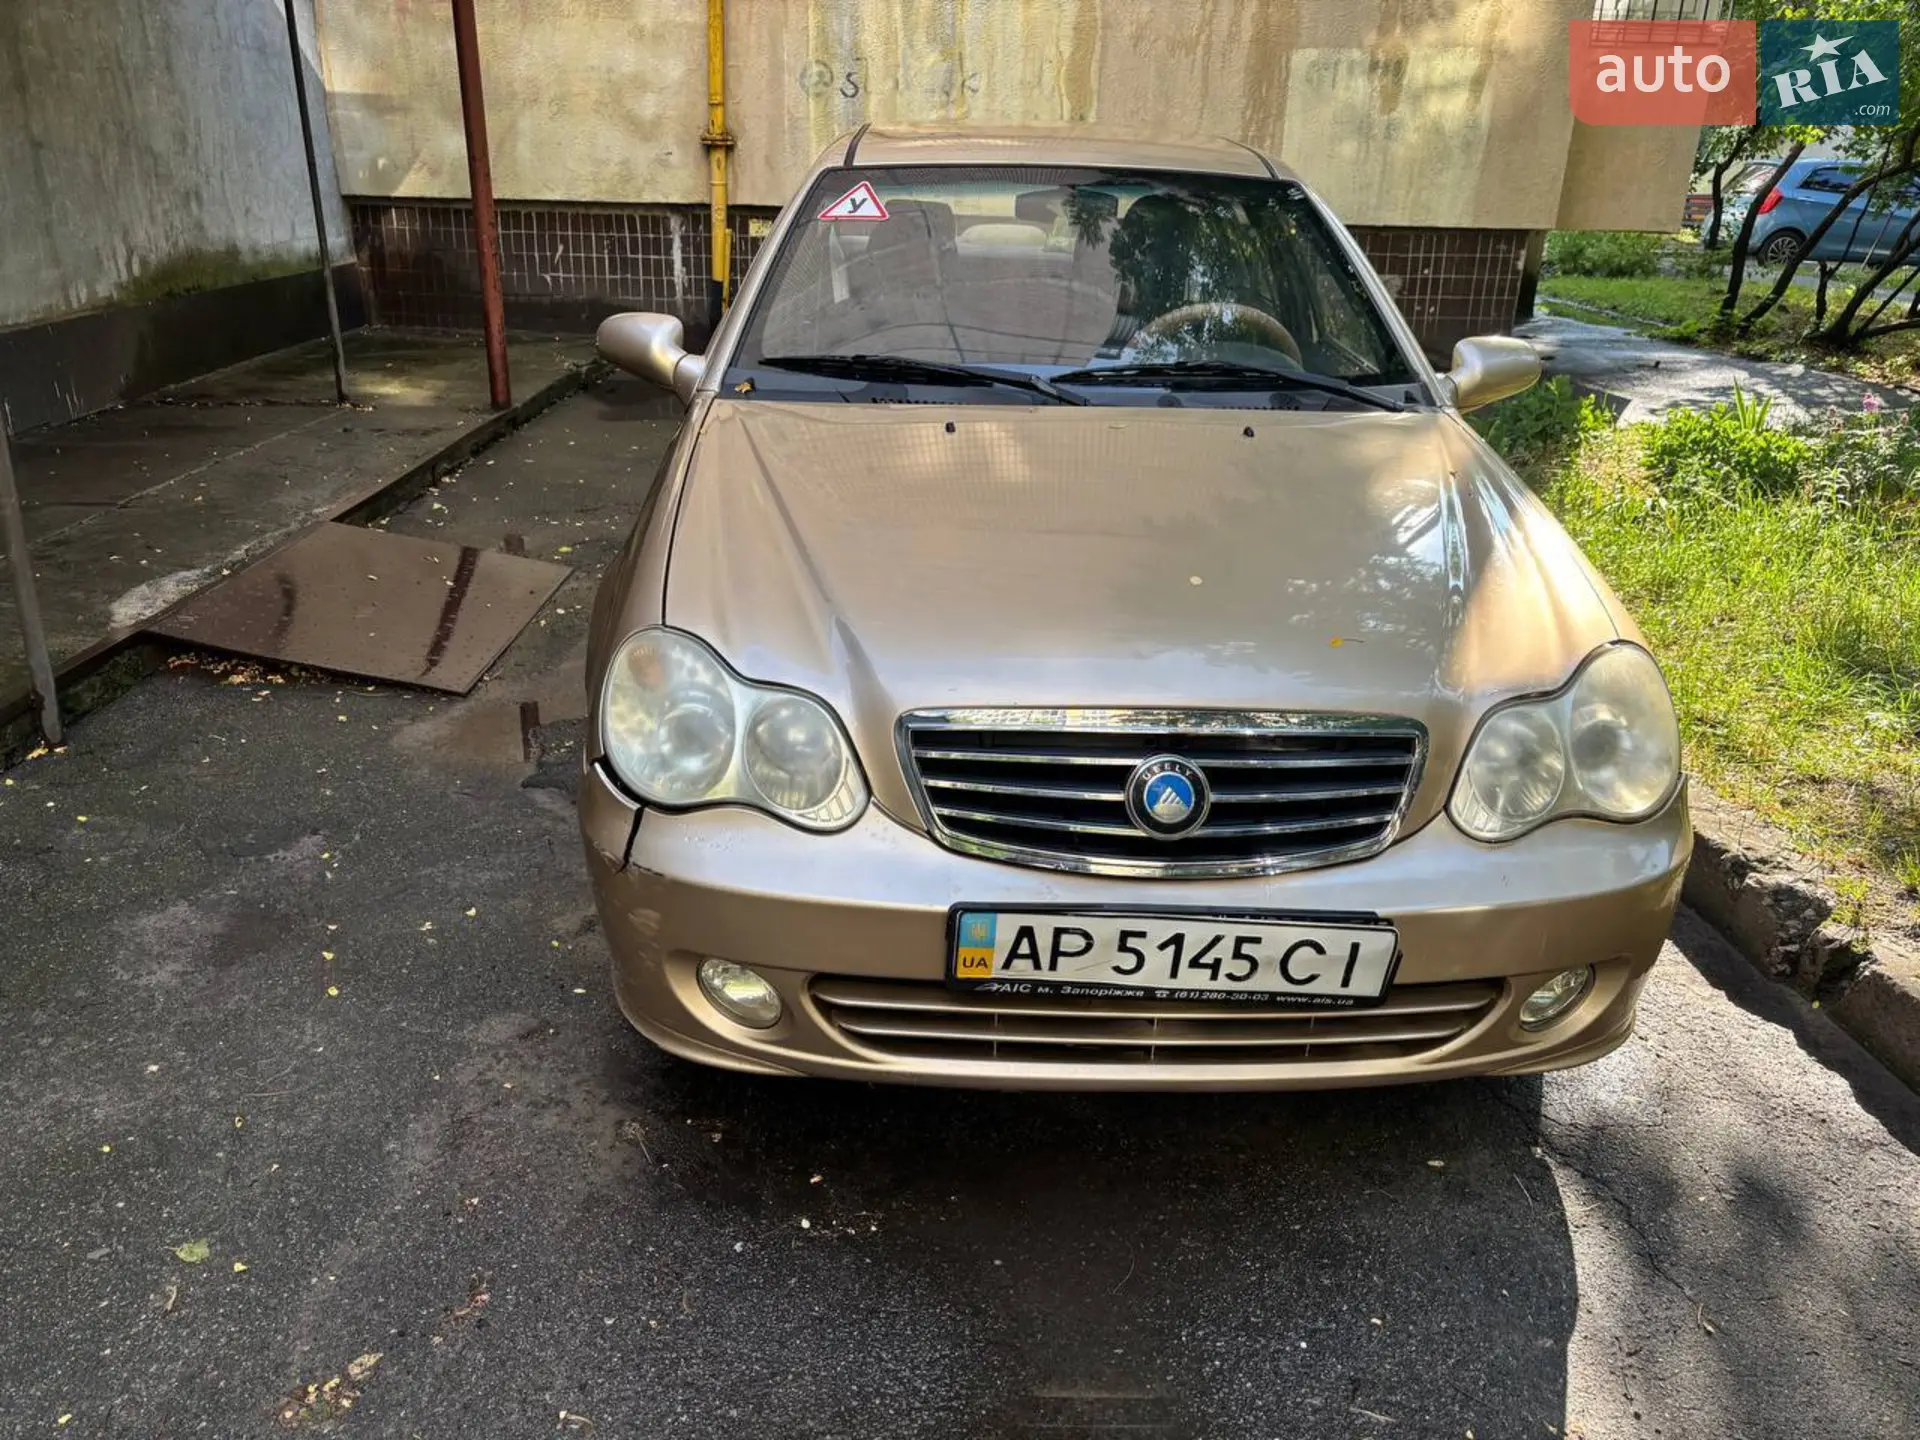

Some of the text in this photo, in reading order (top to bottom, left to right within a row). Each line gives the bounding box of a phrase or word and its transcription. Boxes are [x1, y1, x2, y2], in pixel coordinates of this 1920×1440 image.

[1142, 762, 1194, 780] GEELY
[961, 956, 988, 969] UA
[1001, 925, 1361, 988] AP 5145 CI
[1060, 985, 1144, 997] Запоріжжя
